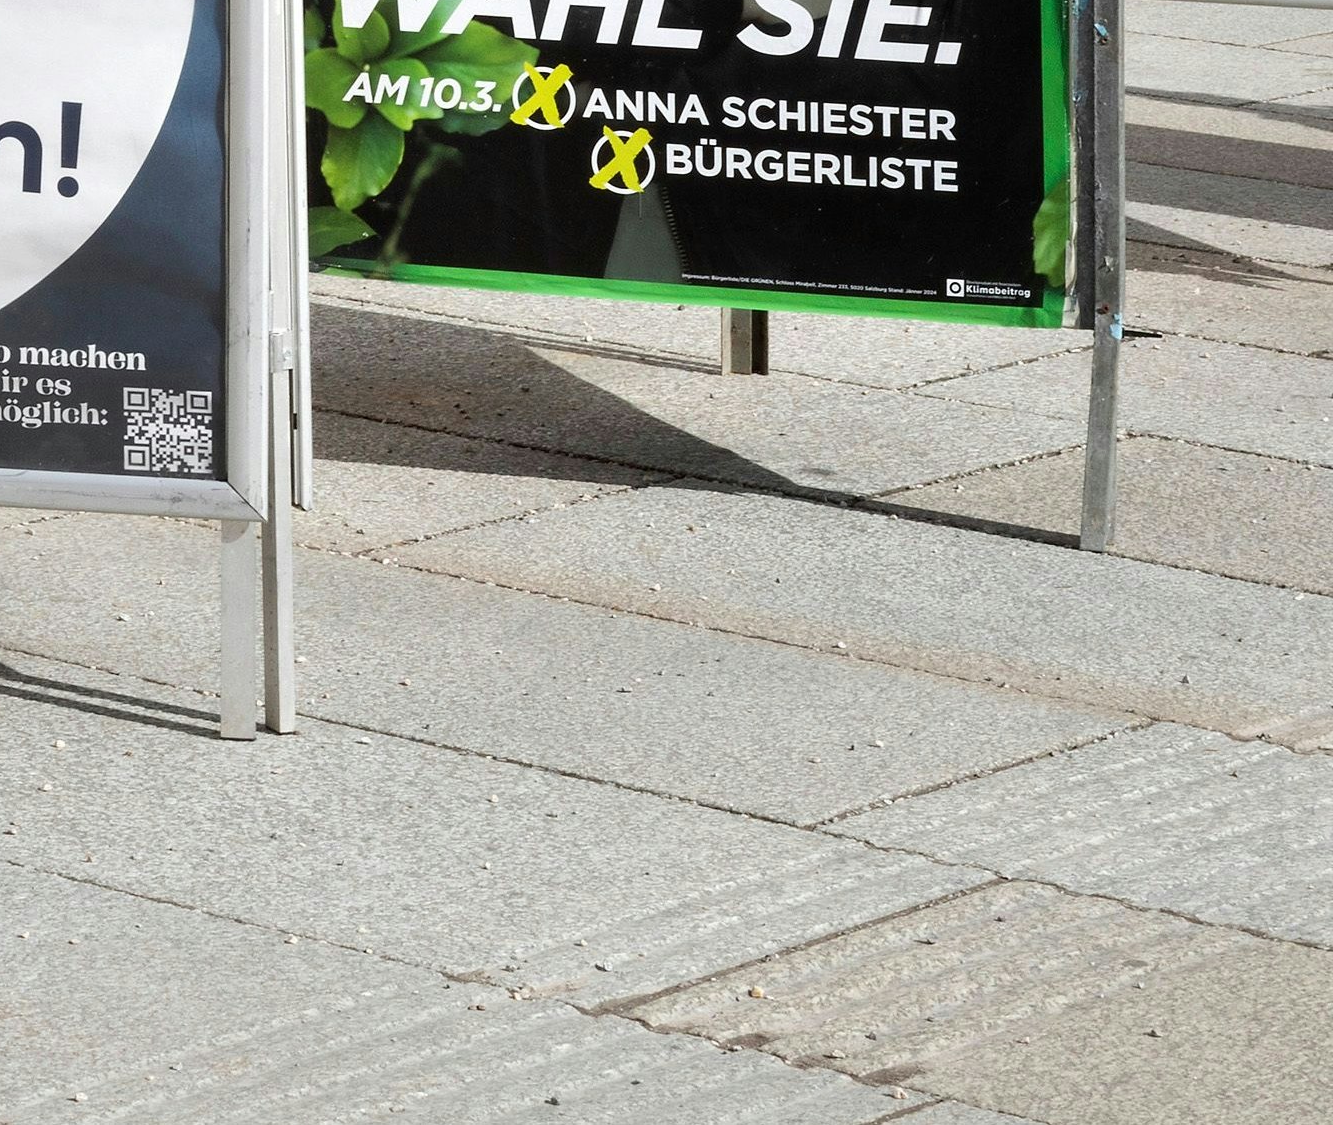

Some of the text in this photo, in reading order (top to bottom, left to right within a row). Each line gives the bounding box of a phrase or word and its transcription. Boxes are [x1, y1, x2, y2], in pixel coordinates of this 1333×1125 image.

[343, 72, 957, 141] AM 10.3. ANNA SCHIESTER
[666, 138, 960, 192] BÜRGERLISTE
[966, 284, 1032, 299] Klimabeitrag
[18, 343, 148, 371] machen
[35, 377, 72, 397] es
